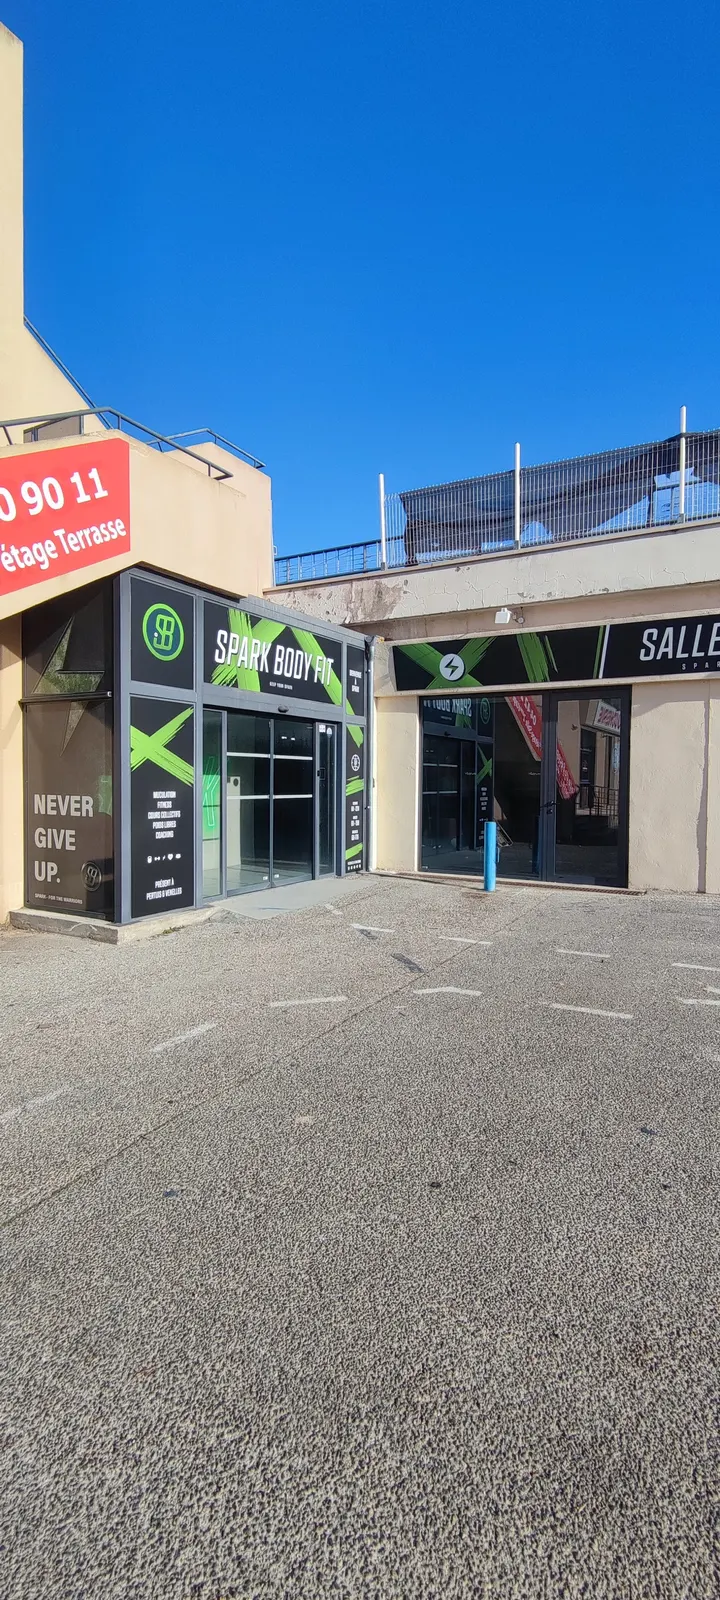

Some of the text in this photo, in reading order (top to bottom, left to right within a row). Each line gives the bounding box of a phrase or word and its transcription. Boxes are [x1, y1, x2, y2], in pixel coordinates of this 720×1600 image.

[20, 476, 65, 516] 90
[70, 468, 109, 504] 11
[53, 518, 127, 555] Terrasse
[214, 629, 334, 686] SPARK BODY FIT
[639, 622, 720, 661] SALLE
[33, 794, 94, 817] NEVER
[34, 827, 76, 851] GIVE
[34, 860, 61, 883] UP.
